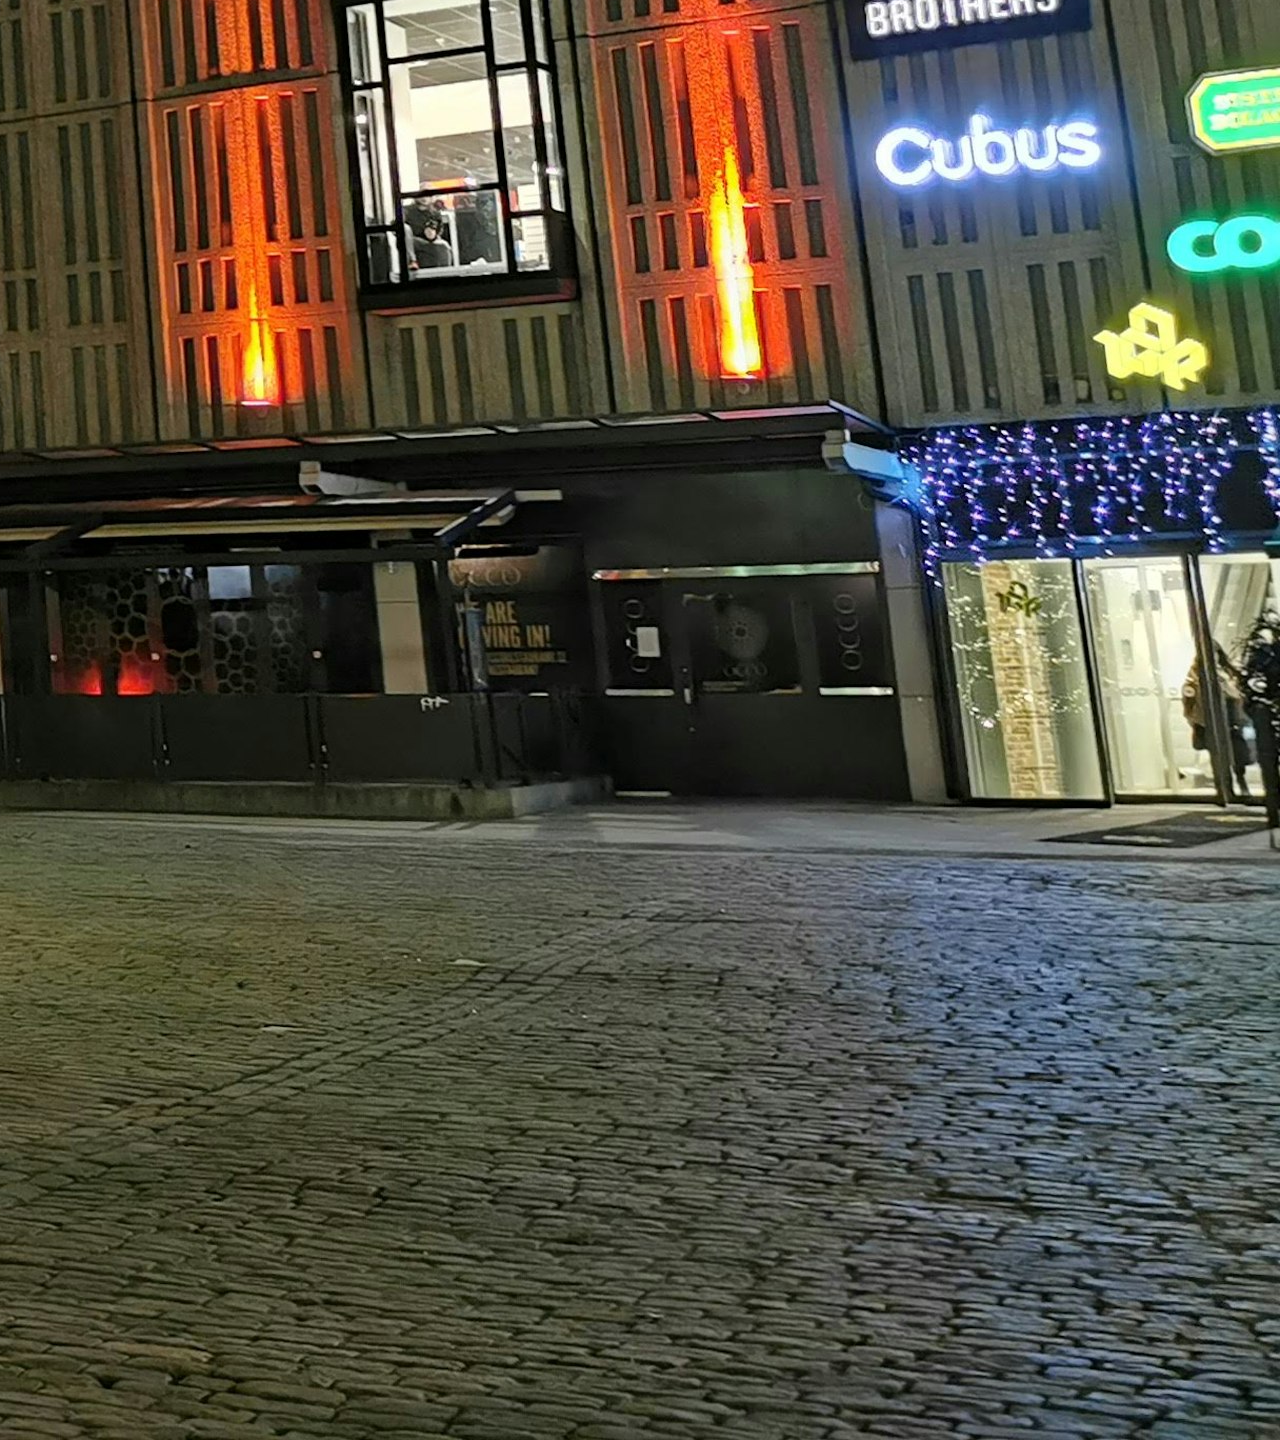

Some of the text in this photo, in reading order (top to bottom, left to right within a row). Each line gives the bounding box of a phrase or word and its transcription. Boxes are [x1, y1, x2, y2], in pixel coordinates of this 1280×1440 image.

[876, 113, 1101, 187] Cubus
[485, 601, 518, 624] ARE
[526, 624, 551, 649] IN!
